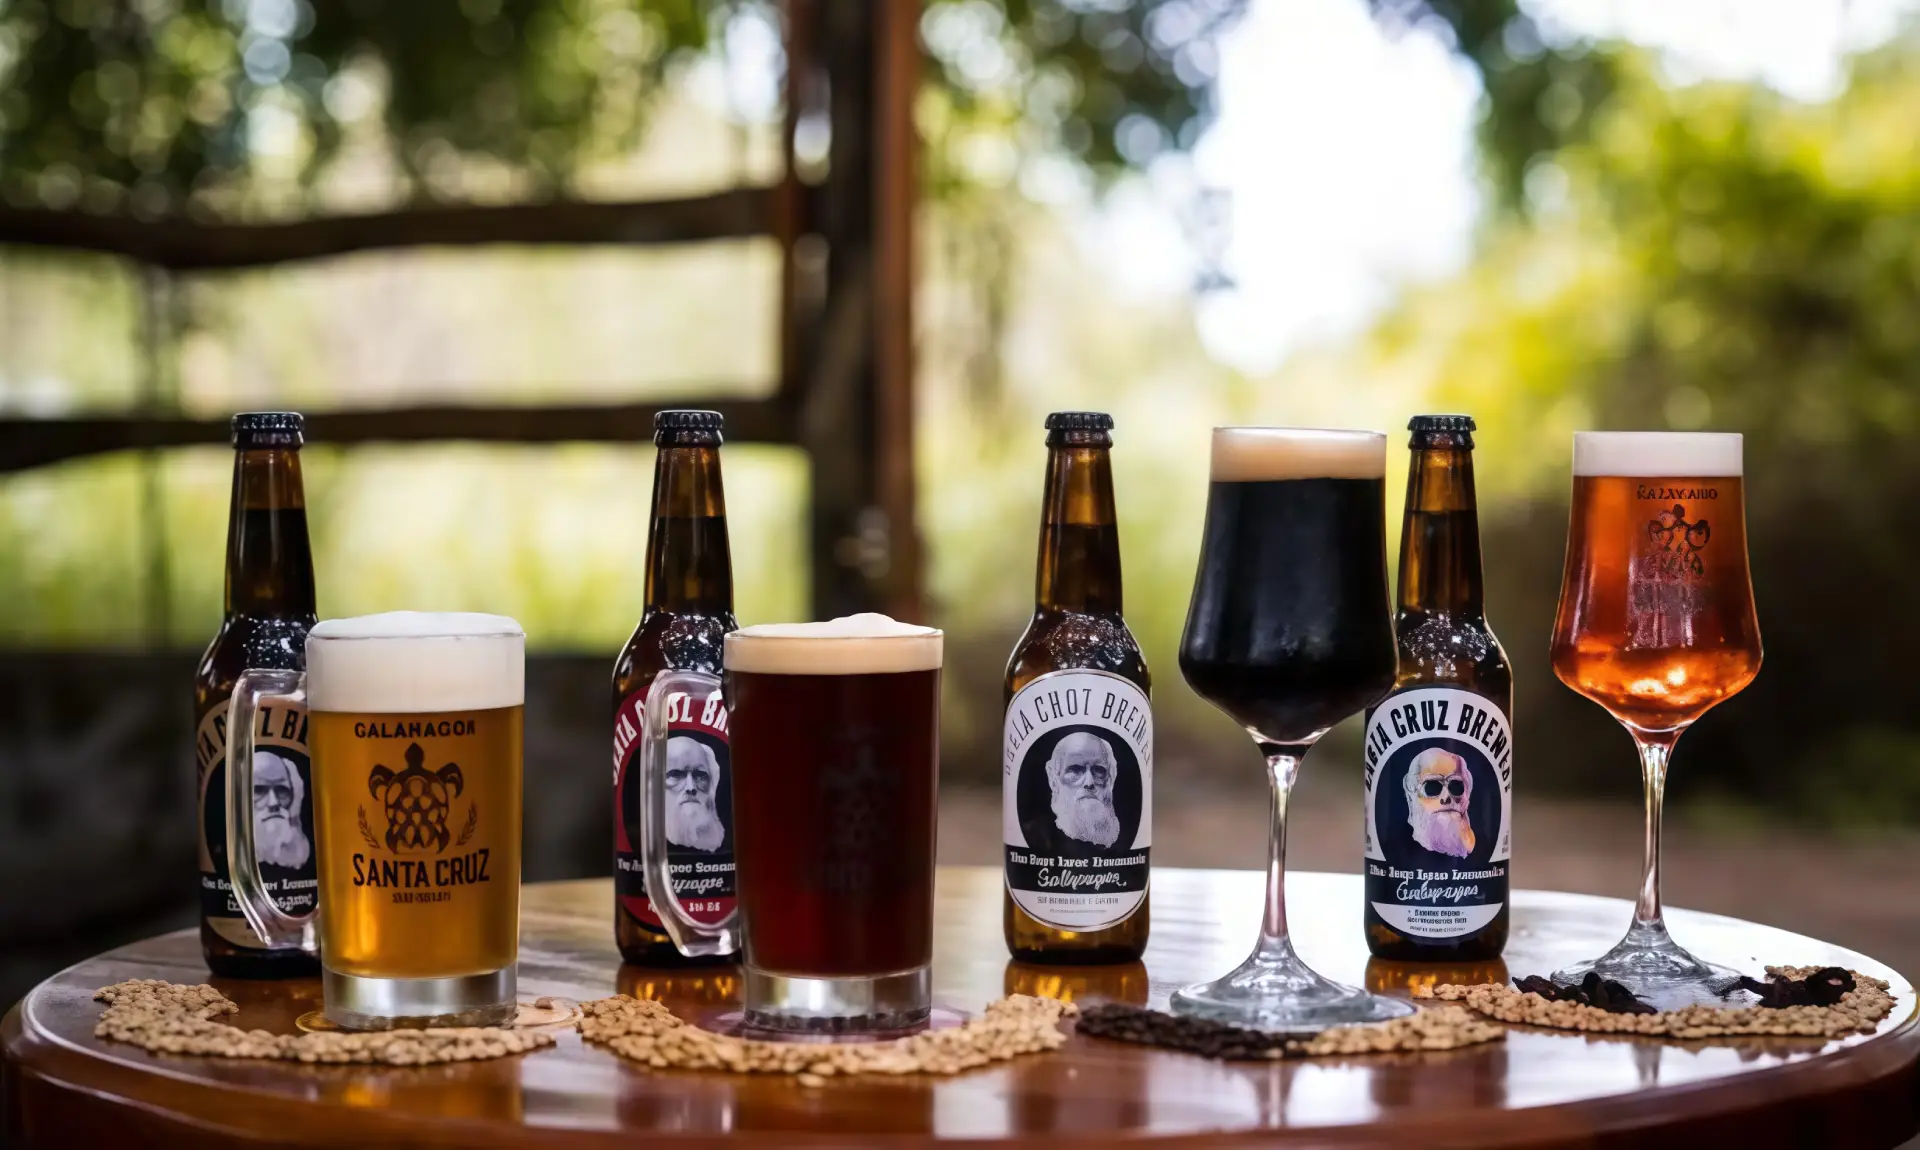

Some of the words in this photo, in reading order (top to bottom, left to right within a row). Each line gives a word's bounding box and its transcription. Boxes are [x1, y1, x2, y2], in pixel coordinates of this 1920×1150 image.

[1390, 700, 1449, 739] CRUZ
[352, 852, 431, 889] SANTA
[435, 848, 490, 888] CRUZ
